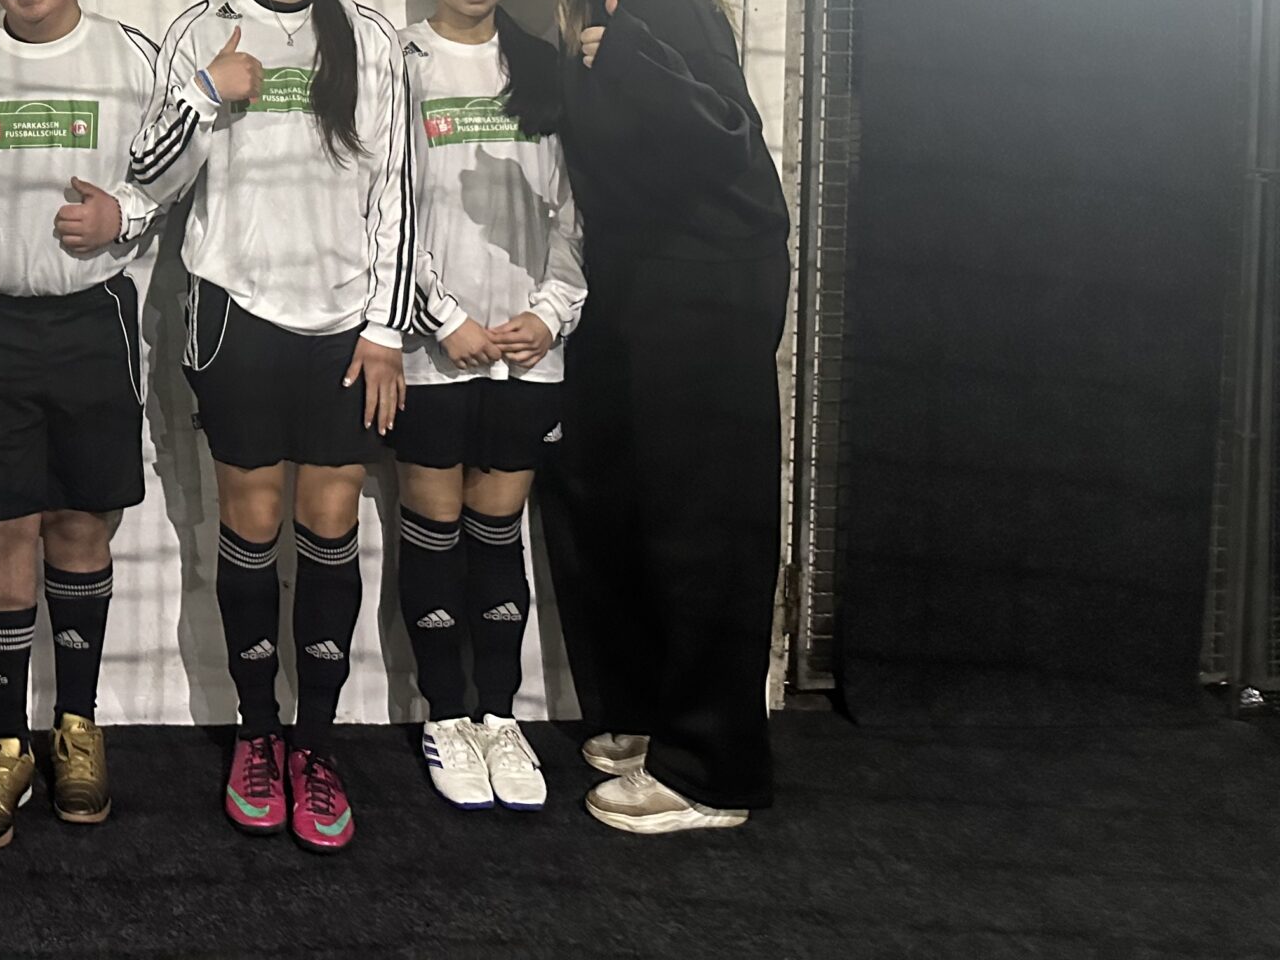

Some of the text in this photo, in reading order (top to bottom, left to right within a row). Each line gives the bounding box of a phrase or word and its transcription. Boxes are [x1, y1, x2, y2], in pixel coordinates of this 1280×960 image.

[12, 121, 60, 129] SPARKASSEN
[5, 129, 67, 138] FUSSBALLSCHULE
[417, 619, 455, 628] adidas
